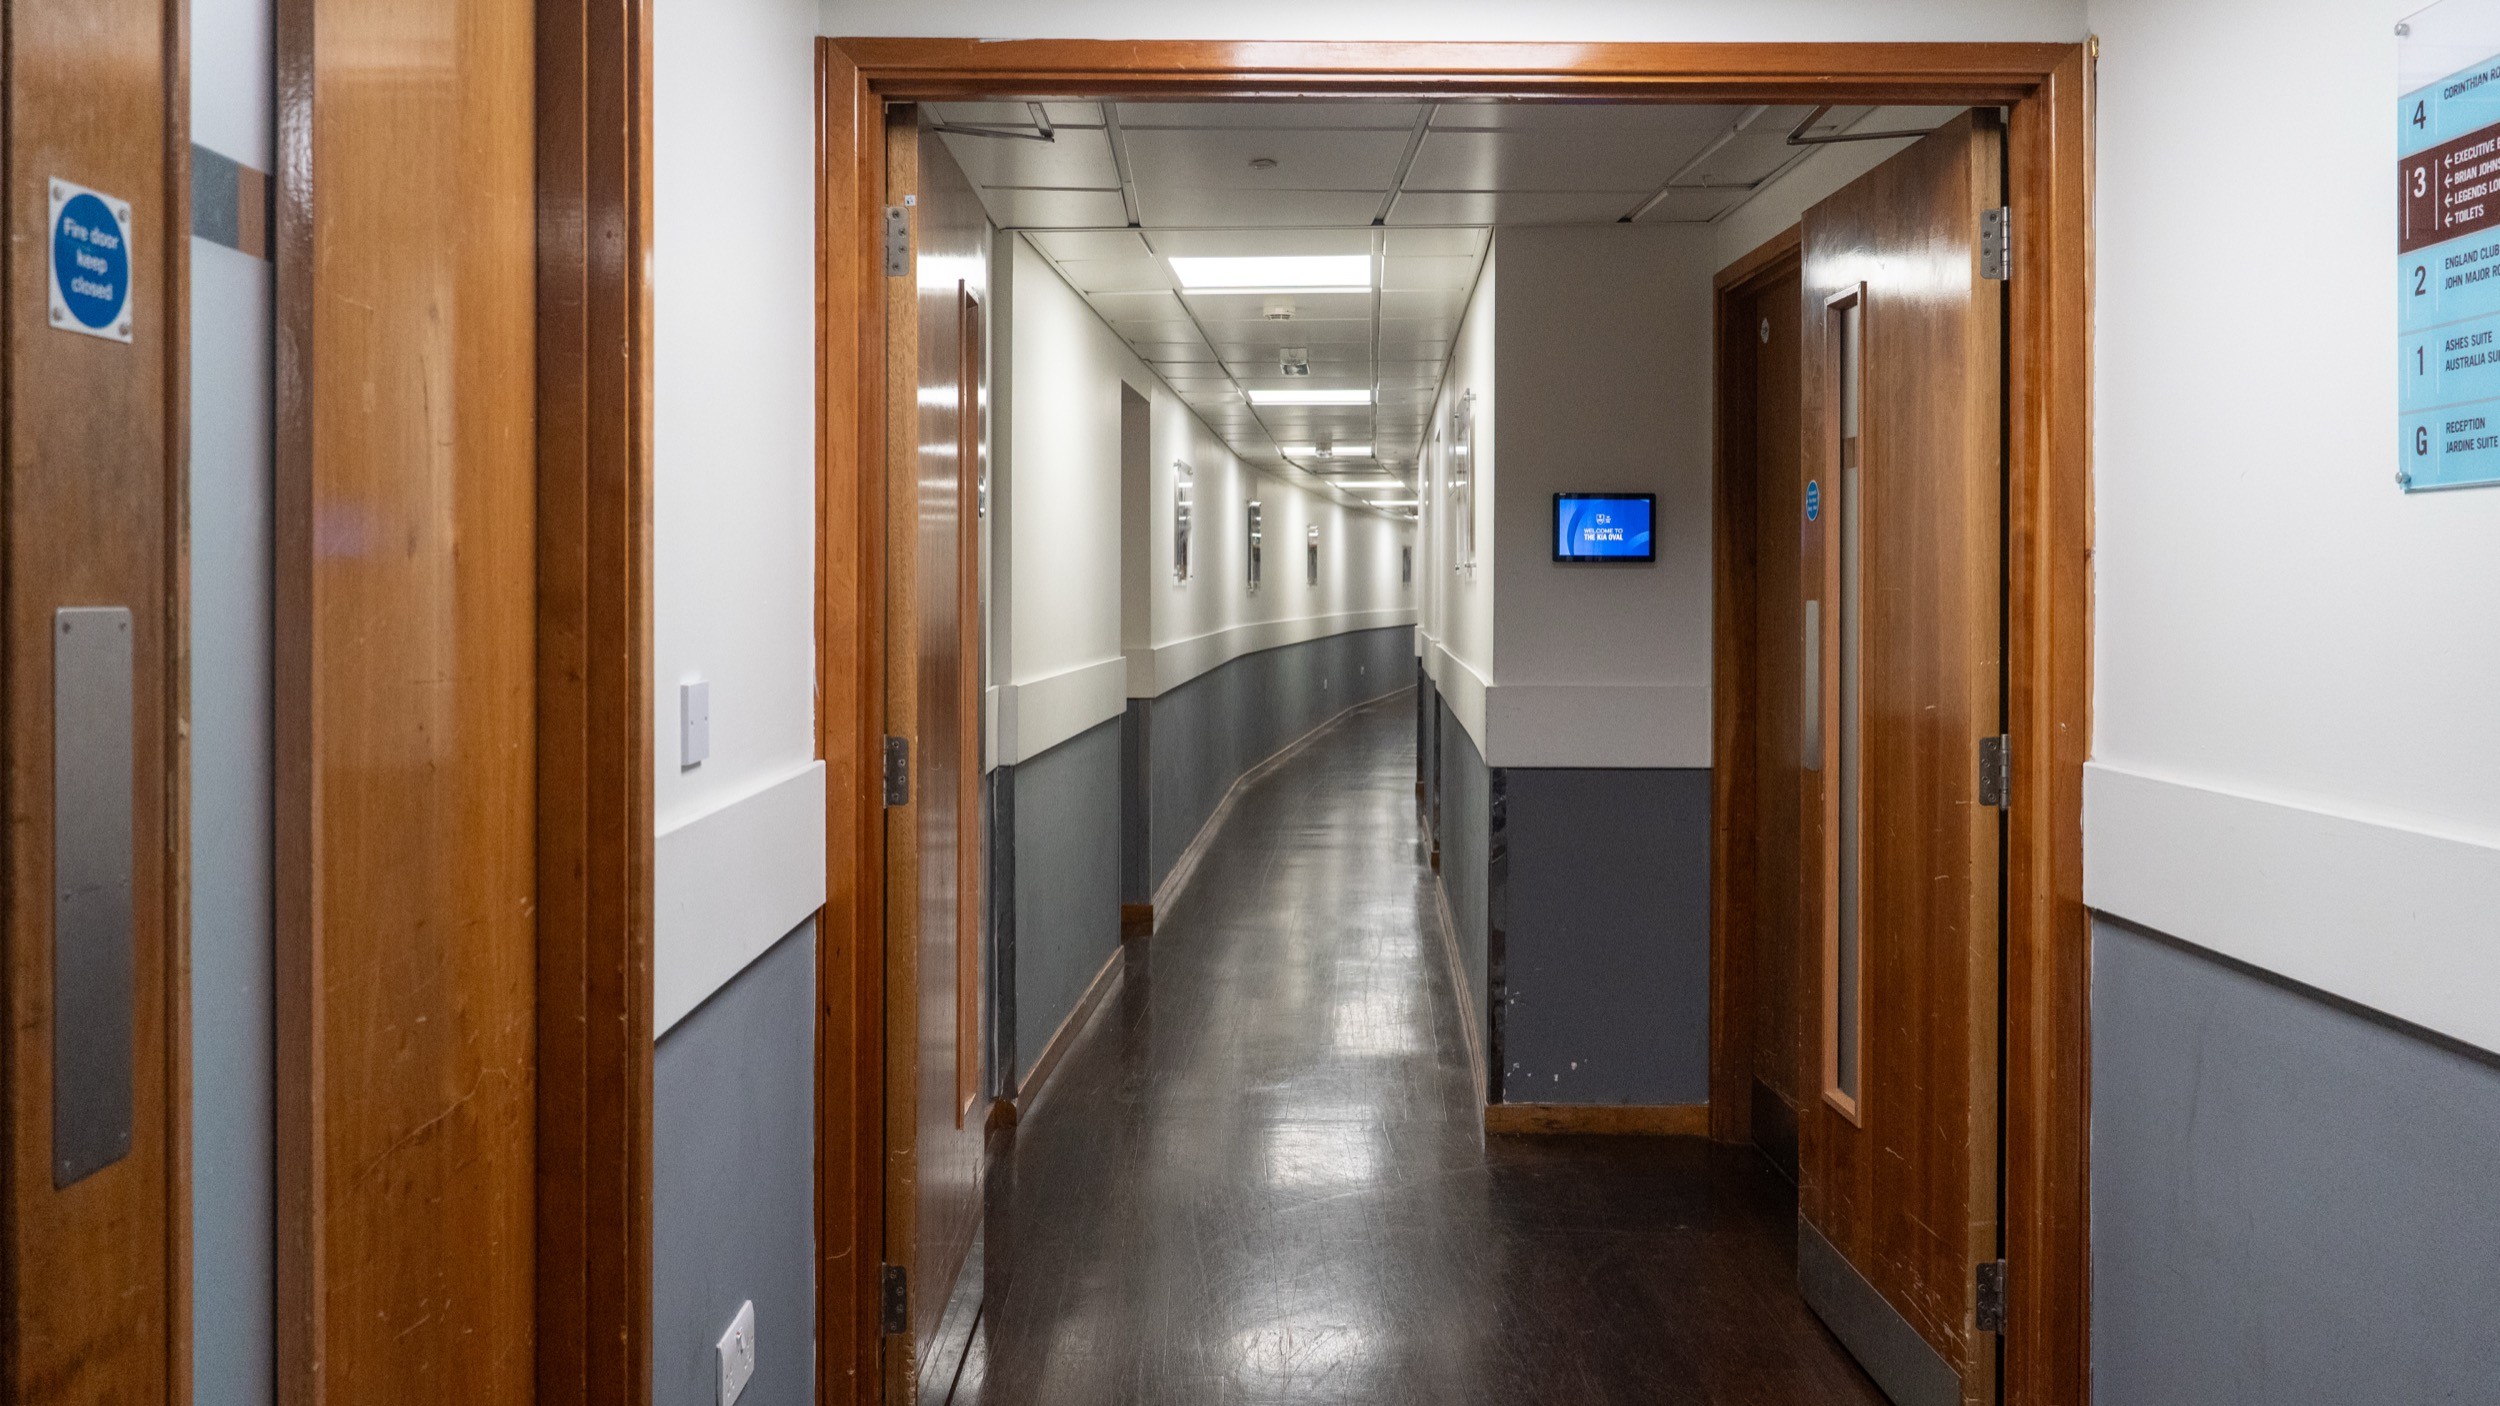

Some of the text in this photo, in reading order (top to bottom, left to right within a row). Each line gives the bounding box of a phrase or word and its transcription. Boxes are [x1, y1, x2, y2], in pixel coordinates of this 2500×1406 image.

[2444, 72, 2488, 100] CORINTHIAN
[2413, 100, 2426, 129] 4
[2454, 139, 2495, 165] EXECUTIVE
[2414, 167, 2426, 198] 3
[2454, 166, 2477, 185] BRIAN
[2454, 182, 2487, 205] LEGENDS
[2454, 204, 2484, 224] TOILETS
[63, 216, 119, 250] Fire door
[76, 248, 108, 276] keep
[2445, 244, 2500, 270] ENGLAND CLUB
[71, 275, 114, 301] closed
[2414, 265, 2426, 297] 2
[2445, 274, 2463, 290] JOHN
[2465, 267, 2490, 284] MAJOR
[2445, 331, 2492, 352] ASHES SUITE
[2416, 345, 2424, 376] 1
[2445, 353, 2486, 371] AUSTRALIA
[2445, 417, 2485, 434] RECEPTION
[2416, 426, 2428, 456] G
[2445, 435, 2498, 453] JARDINE SUITE
